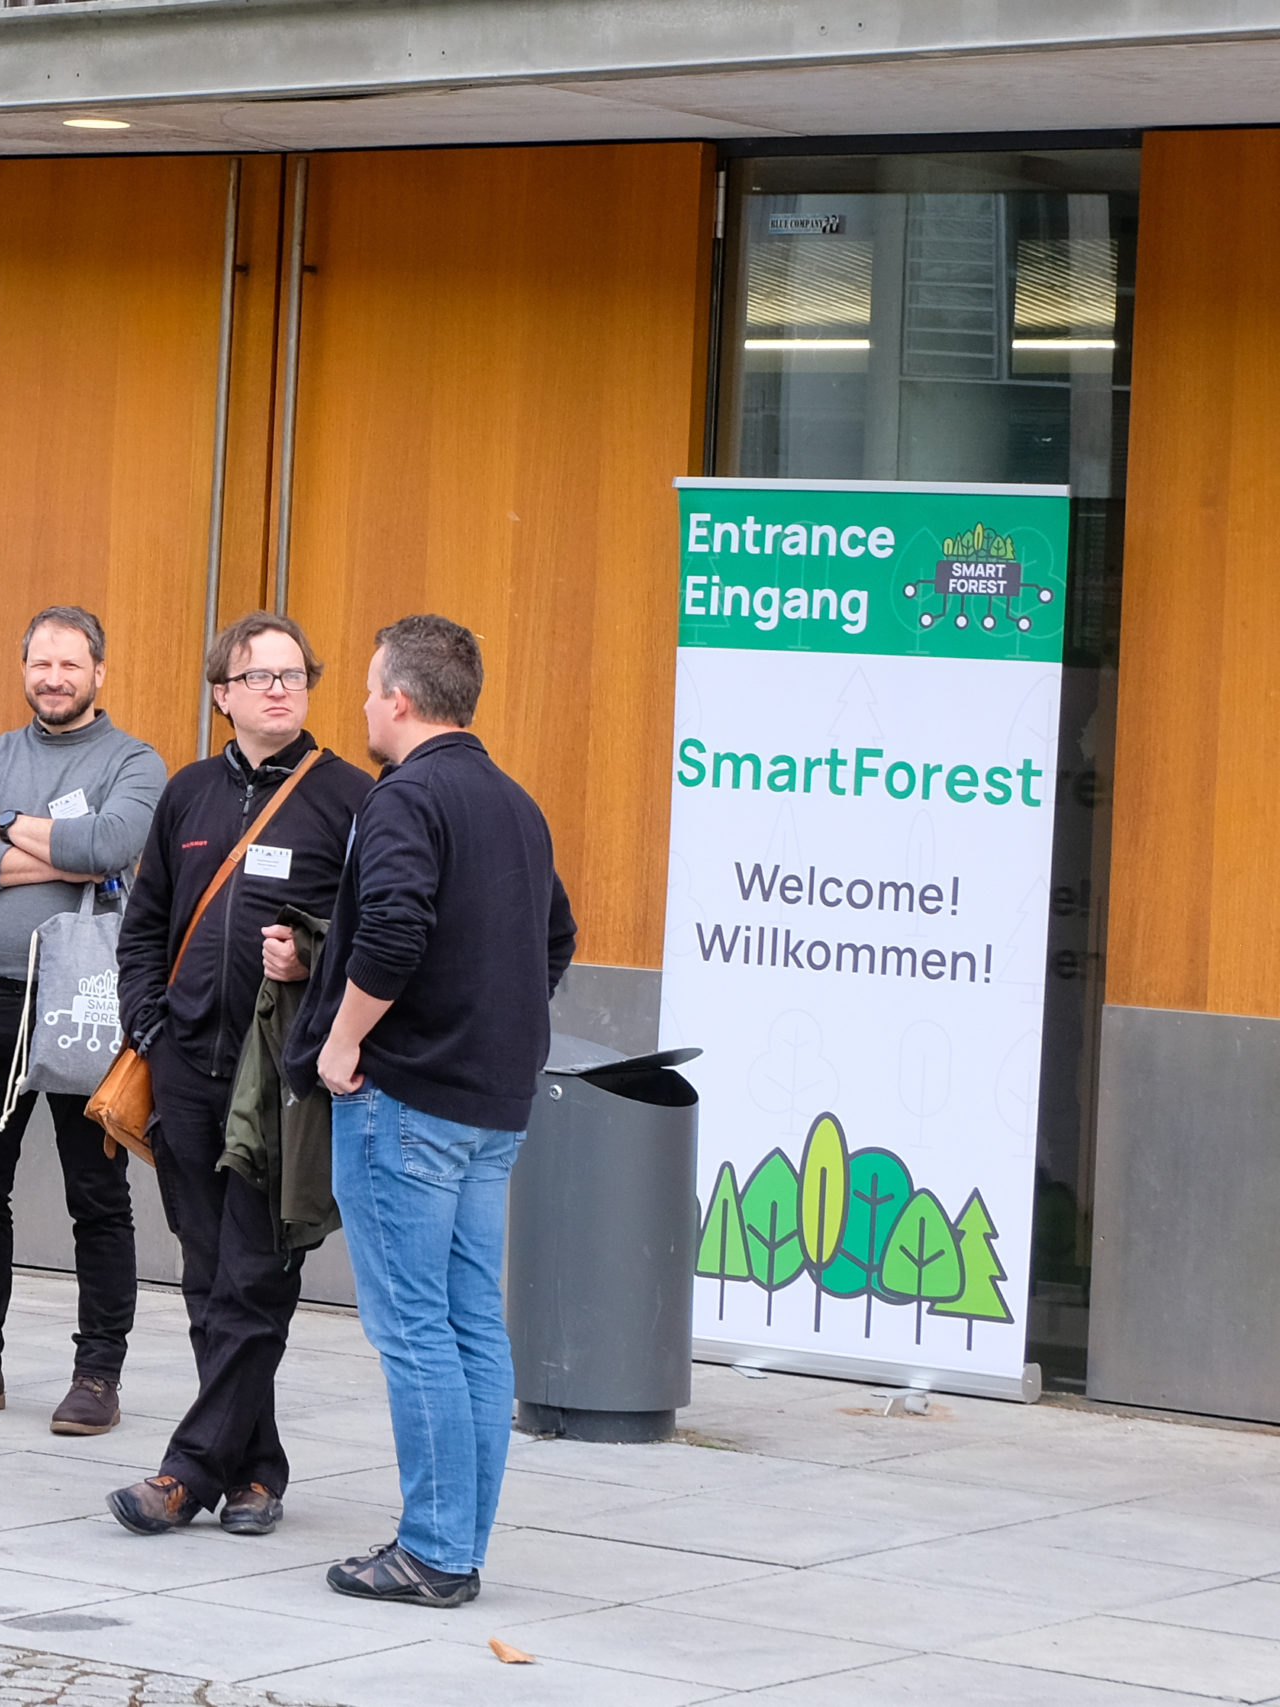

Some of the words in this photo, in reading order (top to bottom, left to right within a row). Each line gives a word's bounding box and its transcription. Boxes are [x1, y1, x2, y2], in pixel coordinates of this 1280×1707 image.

[688, 513, 895, 558] Entrance
[948, 578, 1008, 594] FOREST
[951, 562, 1007, 579] SMART
[685, 575, 868, 634] Eingang
[677, 738, 1043, 807] SmartForest
[734, 862, 960, 916] Welcome!
[695, 922, 993, 984] Willkommen!
